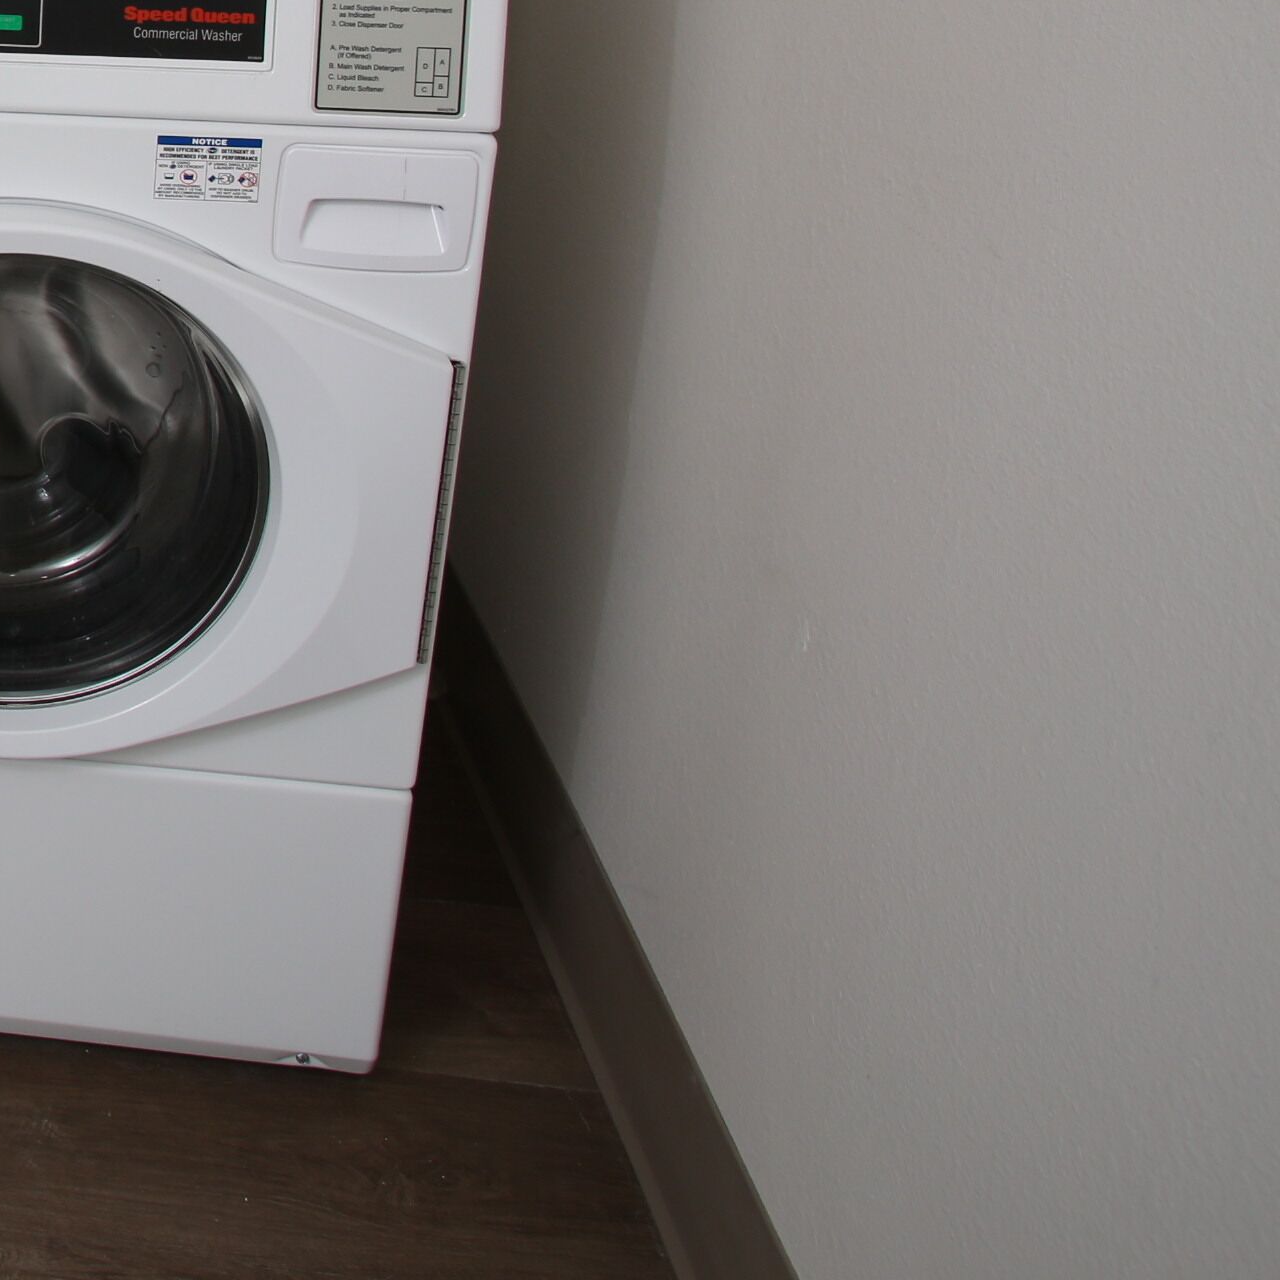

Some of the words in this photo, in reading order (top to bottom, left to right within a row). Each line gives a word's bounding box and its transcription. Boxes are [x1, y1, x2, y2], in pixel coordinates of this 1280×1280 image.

[124, 6, 188, 23] Speed
[191, 8, 256, 24] Queen
[357, 21, 387, 29] Dispenser
[133, 26, 198, 40] Commercial
[201, 29, 243, 42] Washer
[192, 138, 228, 146] NOTICE
